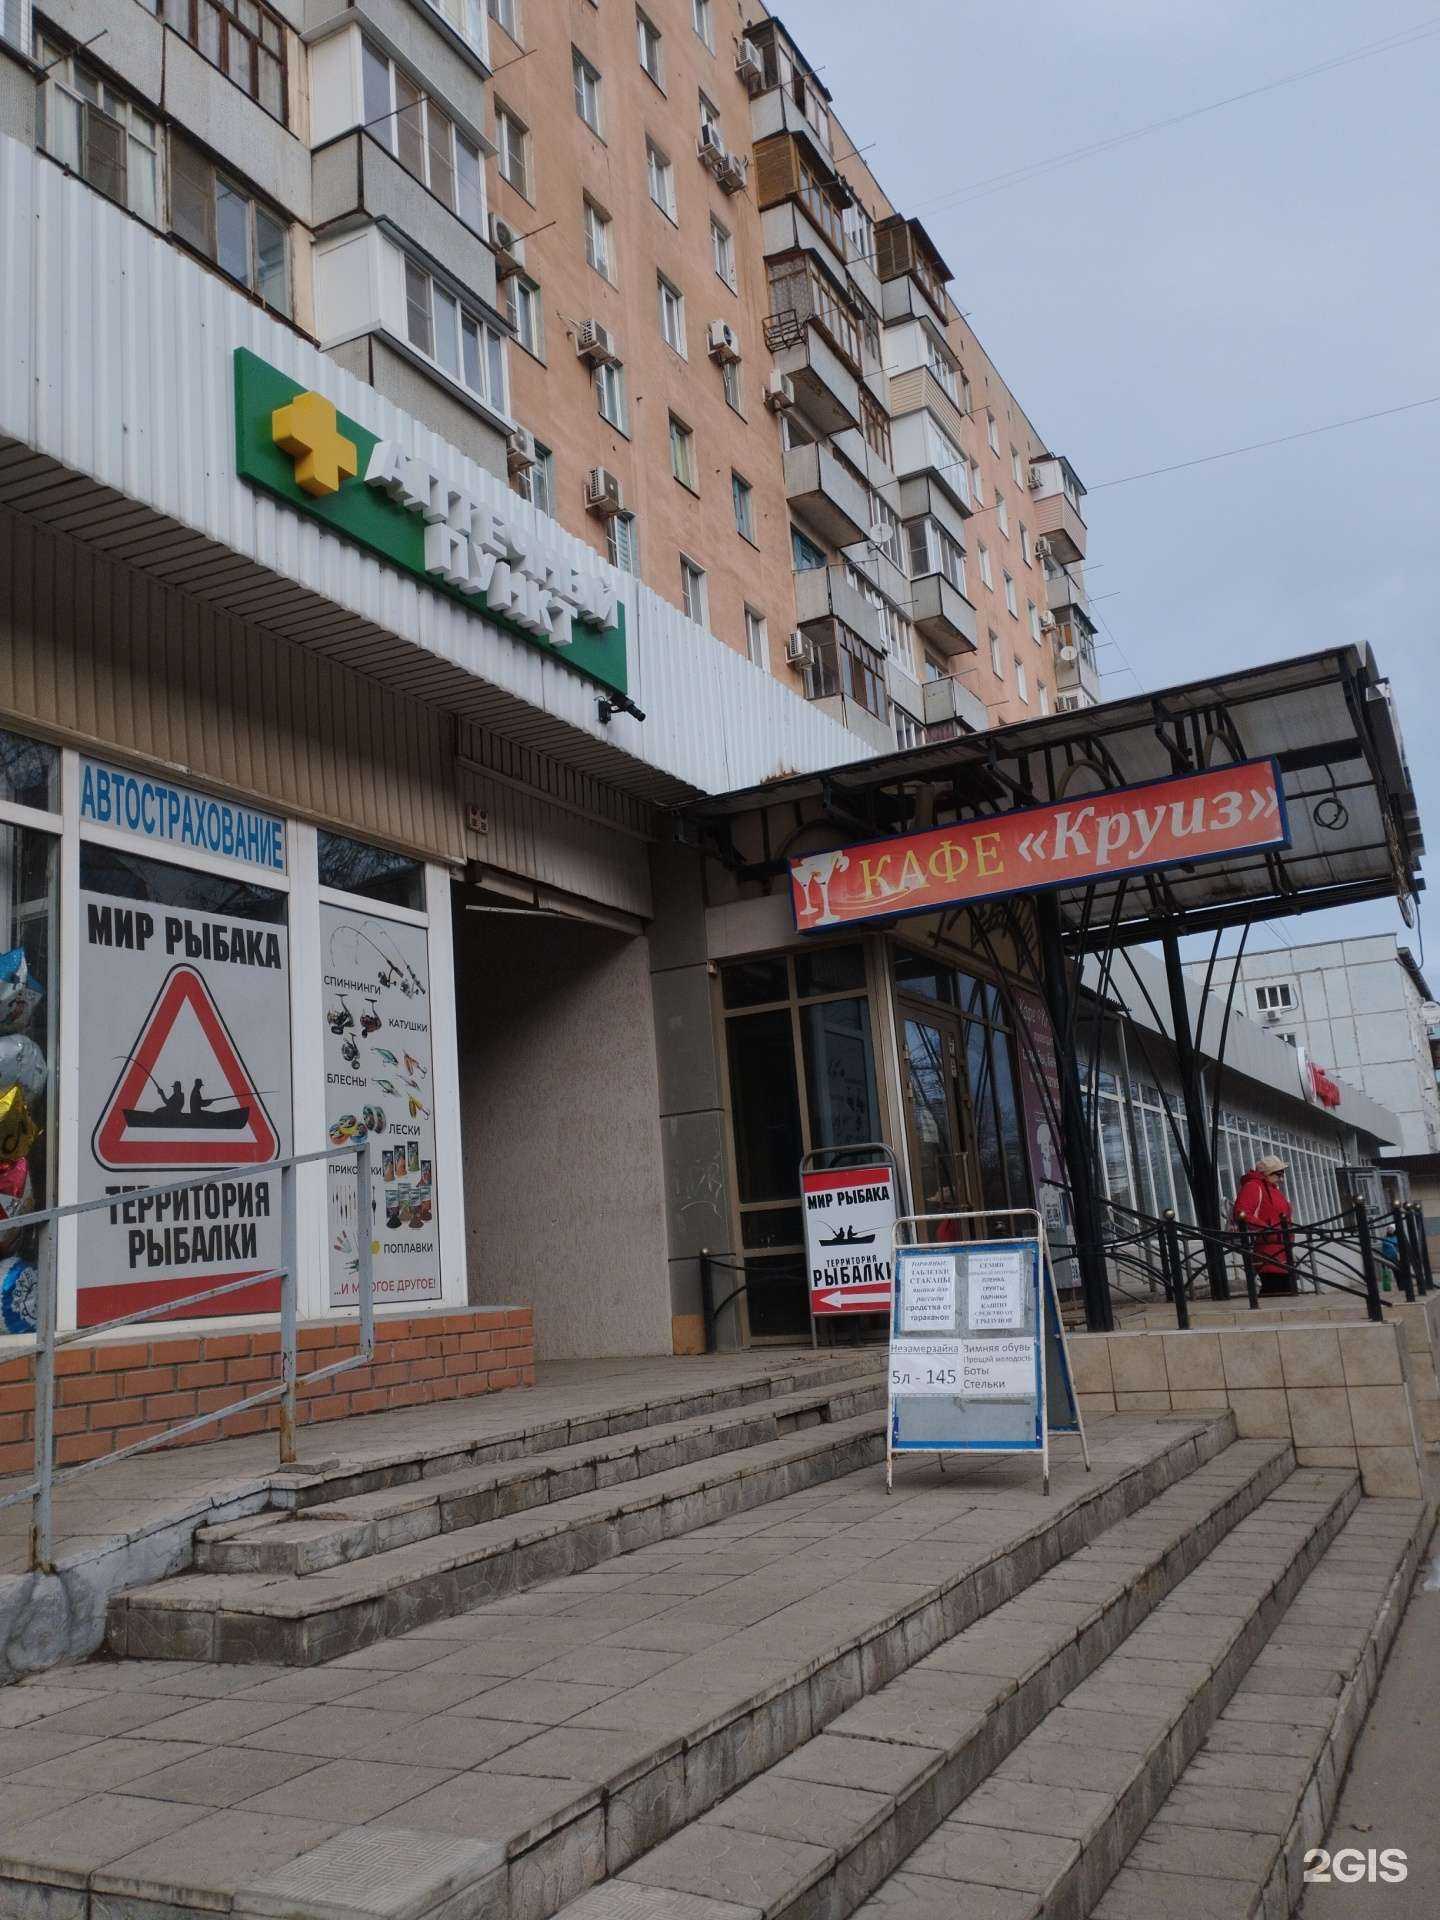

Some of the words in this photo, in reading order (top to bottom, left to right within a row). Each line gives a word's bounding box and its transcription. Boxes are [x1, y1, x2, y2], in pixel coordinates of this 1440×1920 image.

[424, 522, 578, 647] ПУНКТ
[81, 765, 283, 869] АВТОСТРАХОВАНИЕ
[860, 832, 1004, 899] КАФЕ
[1018, 785, 1279, 865] «Круиз»
[88, 904, 154, 950] МИР
[165, 916, 281, 969] РЫБАКА
[324, 976, 381, 995] СПИННИНГИ
[388, 1018, 428, 1032] КАТУШКИ
[327, 1074, 367, 1087] БЛЕСНЫ
[389, 1124, 421, 1136] ЛЕСКИ
[328, 1165, 382, 1176] ПРИКОКИ
[105, 1182, 269, 1224] ТЕРРИТОРИЯ
[808, 1194, 832, 1210] МИР
[837, 1186, 890, 1205] РЫБАКА
[129, 1223, 257, 1268] РЫБАЛКИ
[383, 1243, 433, 1254] ПОПЛАВКИ
[826, 1255, 877, 1267] ТЕРРИТОРИЯ
[963, 1344, 1000, 1353] Зимняя
[1002, 1342, 1031, 1352] обувь
[892, 1370, 910, 1385] 5л
[926, 1369, 957, 1384] 145
[963, 1366, 989, 1376] Боты
[963, 1379, 1006, 1389] Стельки
